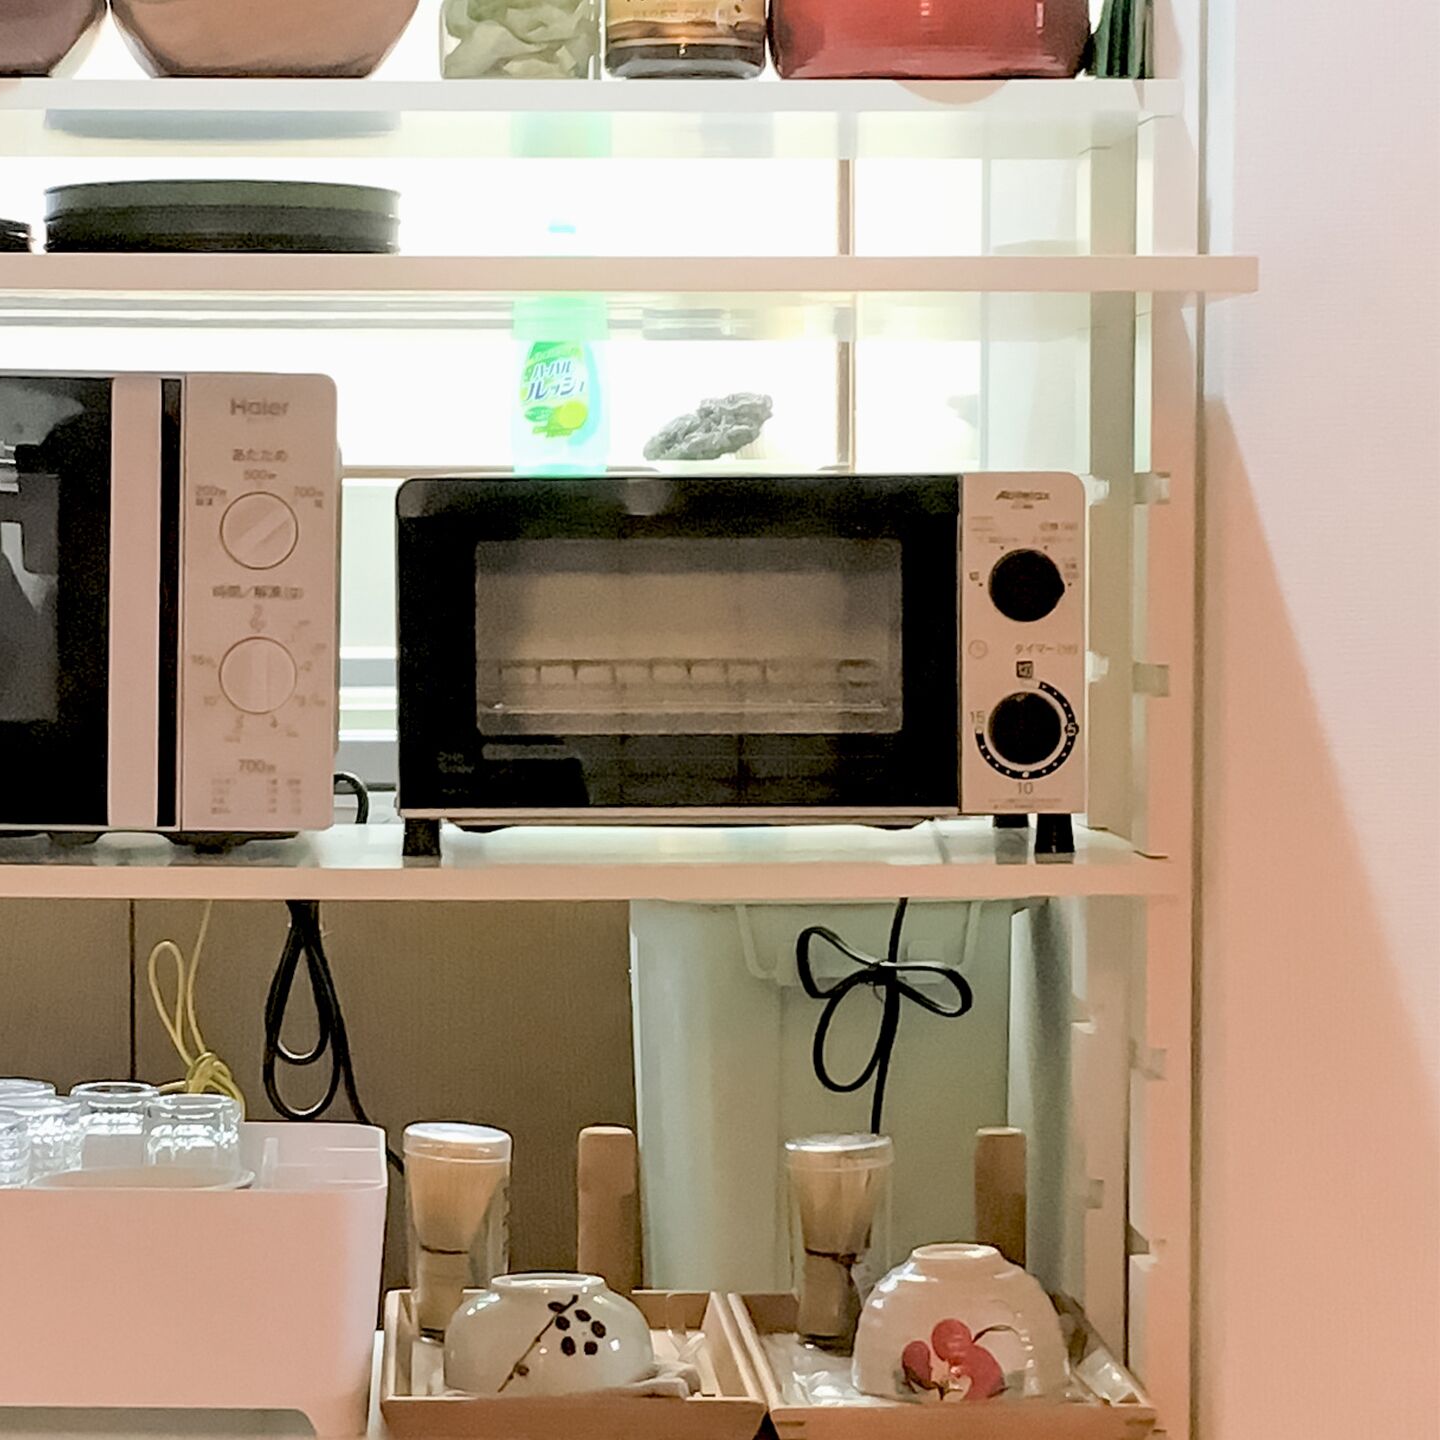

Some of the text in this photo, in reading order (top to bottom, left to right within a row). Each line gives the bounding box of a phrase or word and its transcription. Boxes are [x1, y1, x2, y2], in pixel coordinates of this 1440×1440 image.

[230, 398, 289, 416] Haier
[970, 710, 985, 724] 15
[1017, 782, 1034, 795] 10
